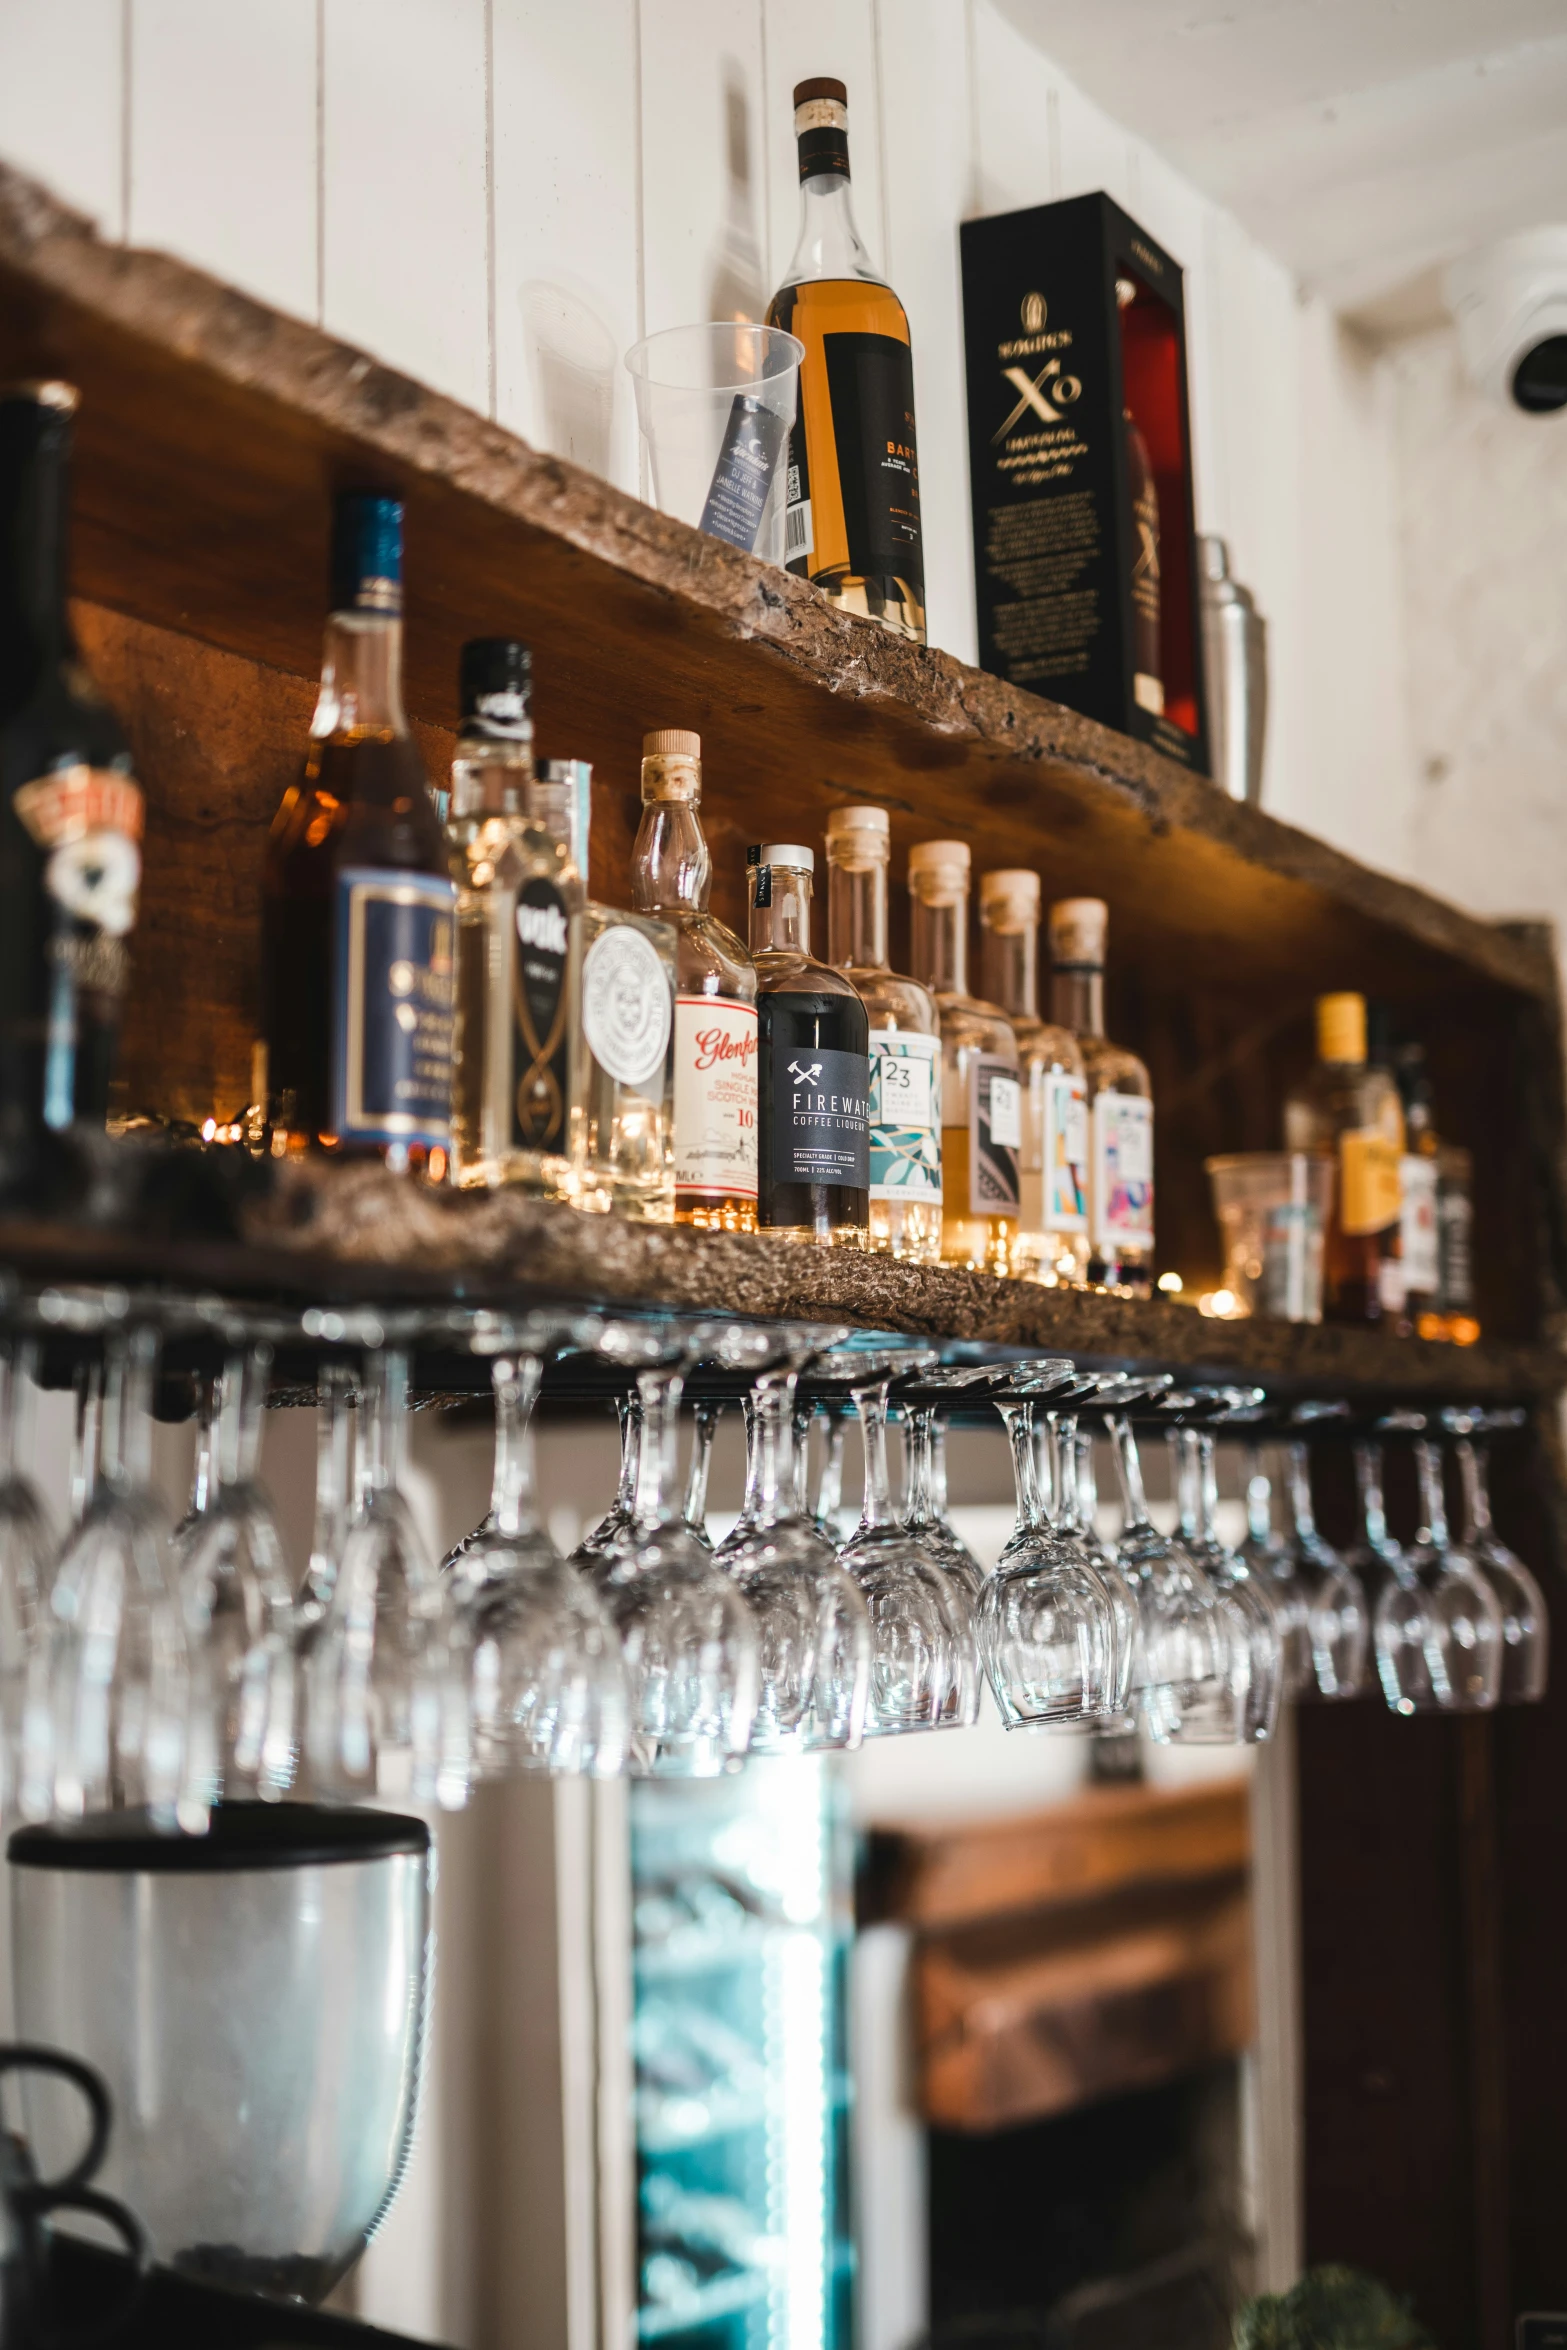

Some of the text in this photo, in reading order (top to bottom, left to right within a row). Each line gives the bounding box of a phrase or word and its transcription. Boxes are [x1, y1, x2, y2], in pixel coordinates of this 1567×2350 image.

[886, 441, 917, 461] BART
[881, 461, 902, 470] AVERAGE
[717, 475, 741, 494] JANELLE
[731, 468, 740, 482] DJ
[740, 474, 751, 487] JEFF
[886, 1062, 910, 1088] 23
[737, 1107, 754, 1129] 10
[793, 1116, 865, 1132] COFFEE LIQUEUR
[825, 1167, 842, 1175] ALC/VOL
